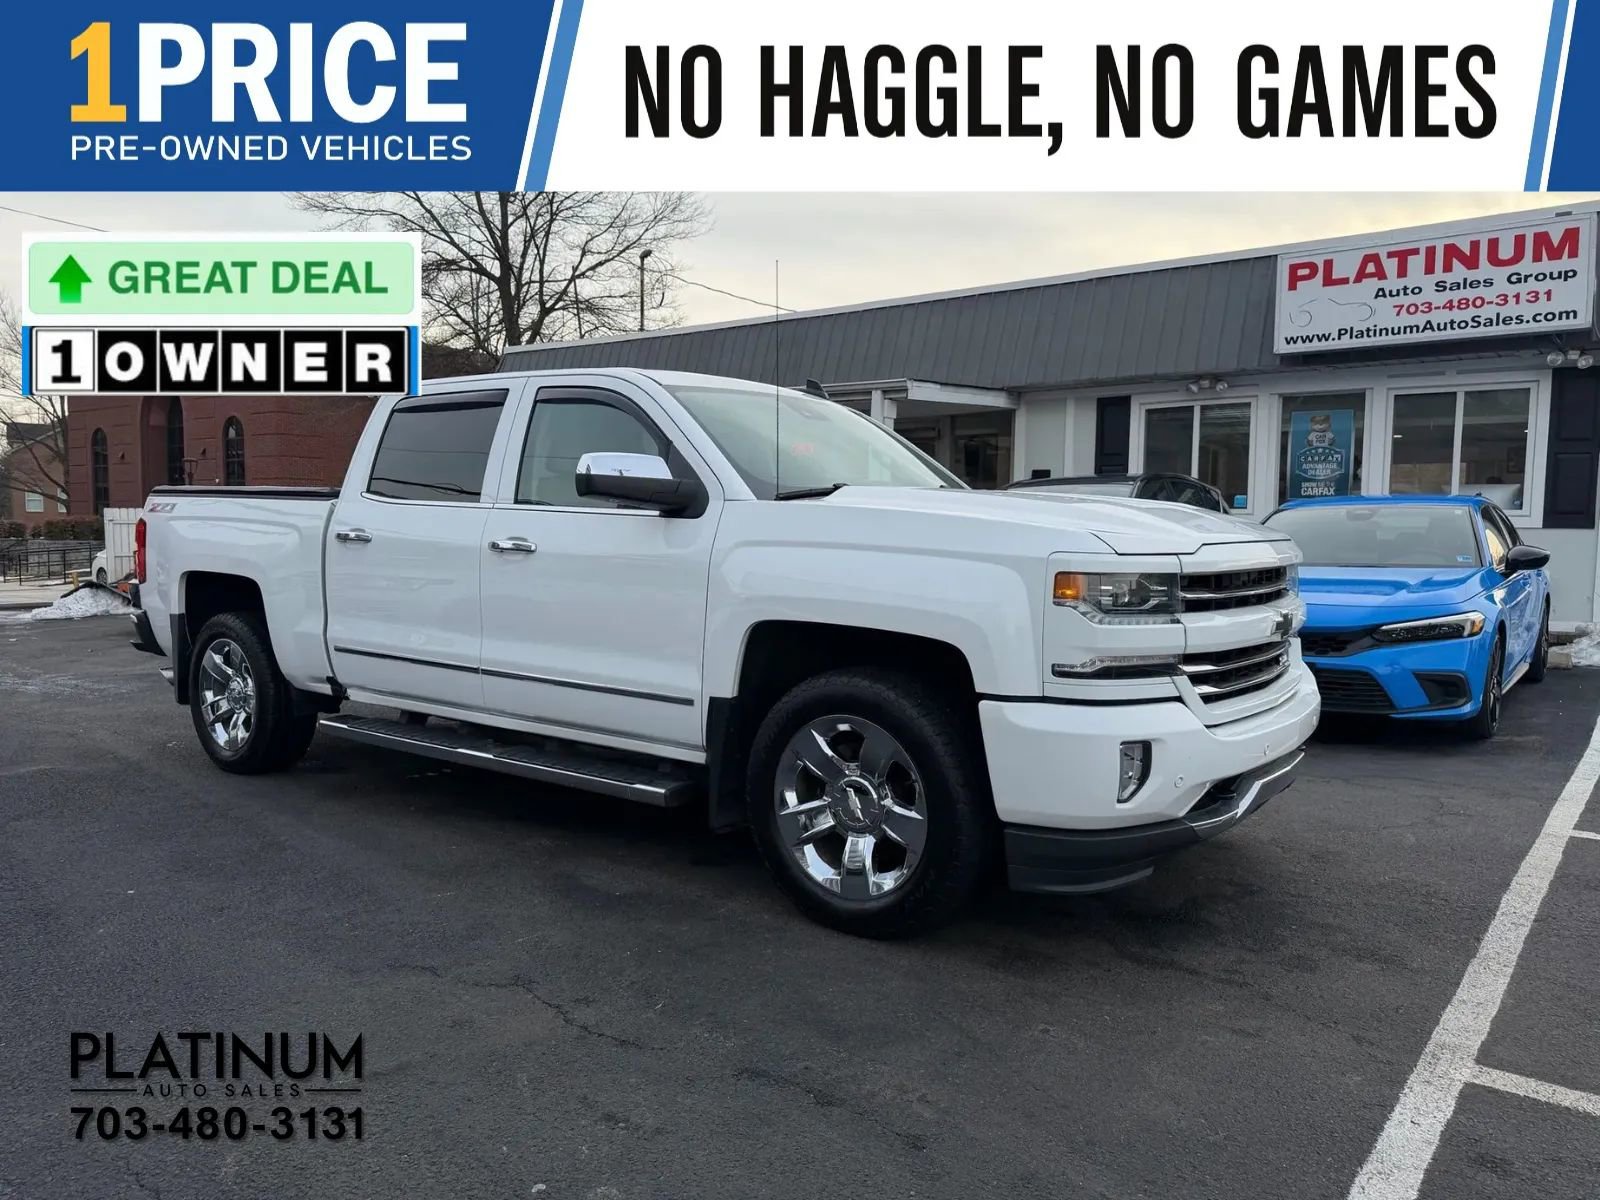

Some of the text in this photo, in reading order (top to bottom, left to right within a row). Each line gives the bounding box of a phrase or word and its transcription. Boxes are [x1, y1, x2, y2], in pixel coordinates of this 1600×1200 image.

[1288, 226, 1580, 291] PLATINUM
[1373, 268, 1578, 300] Auto Sales Group
[1392, 288, 1554, 317] 703-480-3131
[1284, 307, 1578, 346] www.PlatinumAutoSales.com
[1301, 487, 1335, 495] CARFAX
